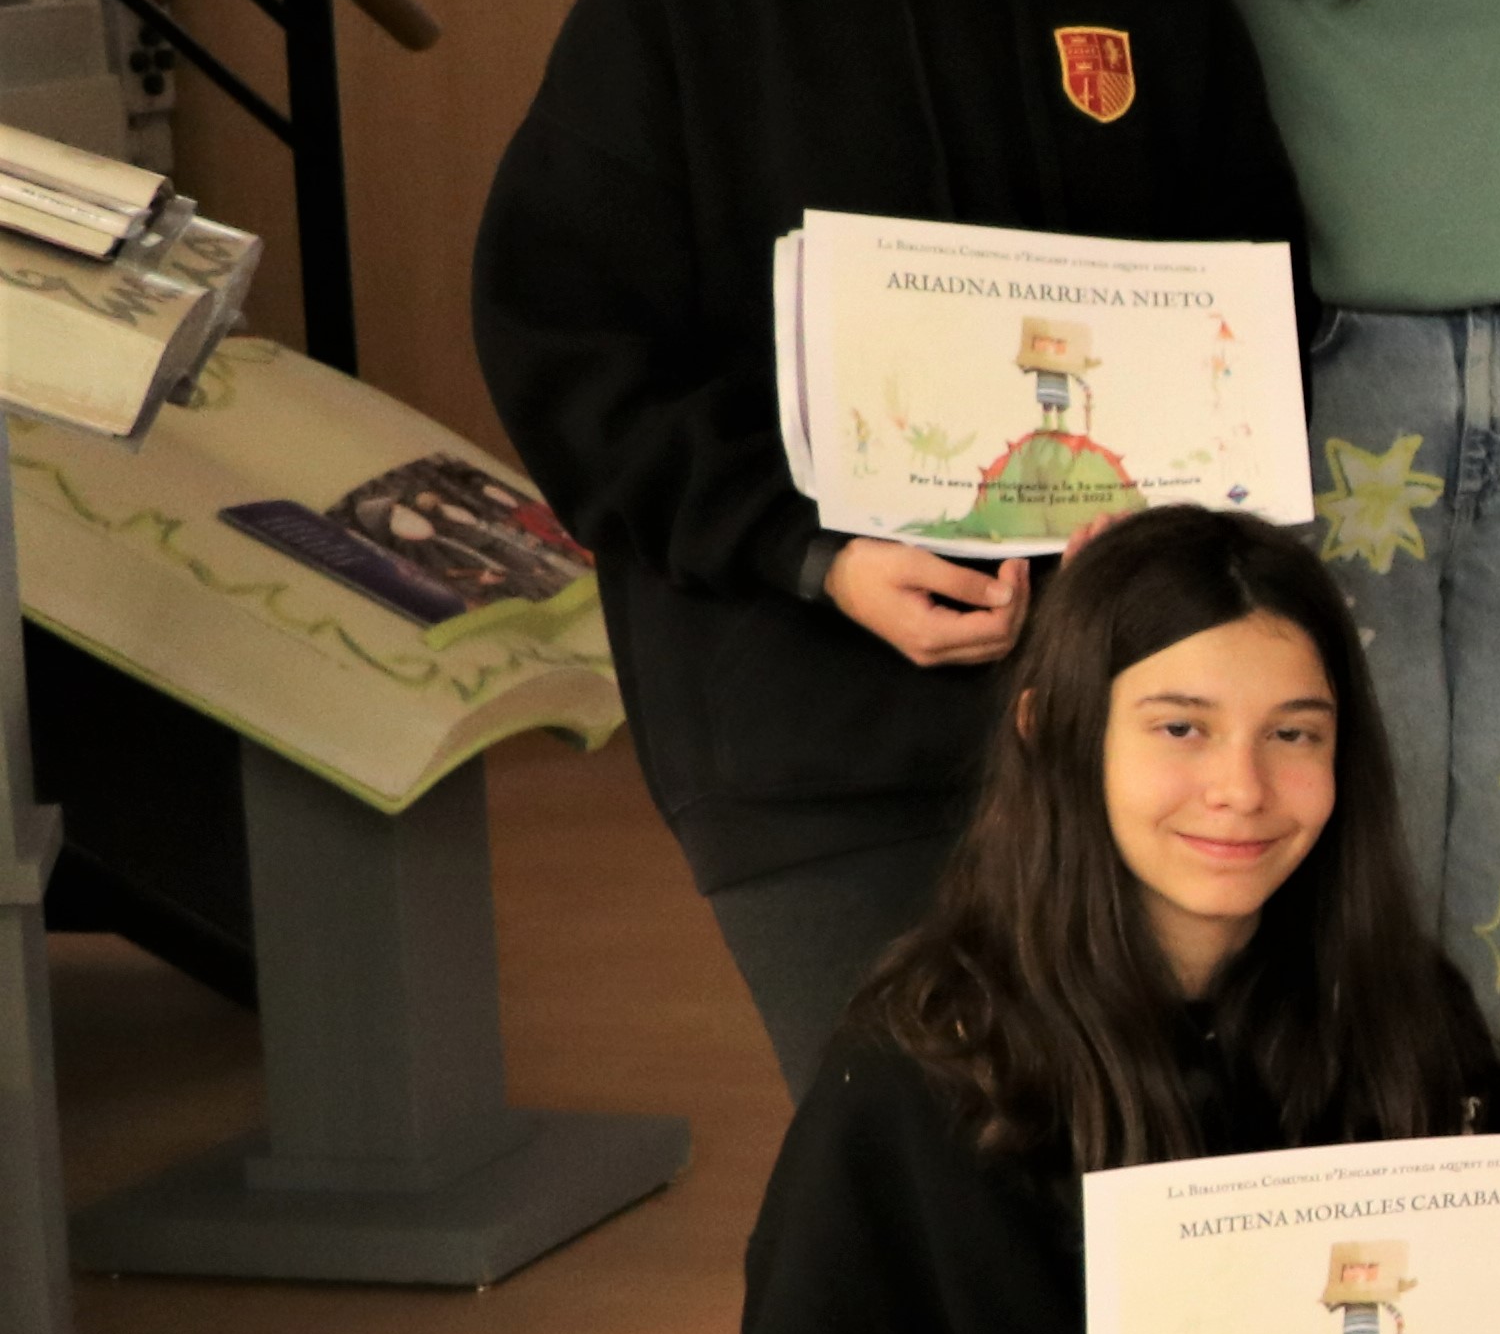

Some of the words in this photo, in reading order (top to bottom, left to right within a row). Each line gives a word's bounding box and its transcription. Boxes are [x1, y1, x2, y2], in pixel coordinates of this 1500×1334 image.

[886, 272, 1001, 296] ARIADNA
[1008, 281, 1125, 303] BARRENA
[1130, 286, 1214, 308] NIETO
[1179, 1209, 1288, 1240] MAITENA
[1294, 1197, 1405, 1224] MORALES
